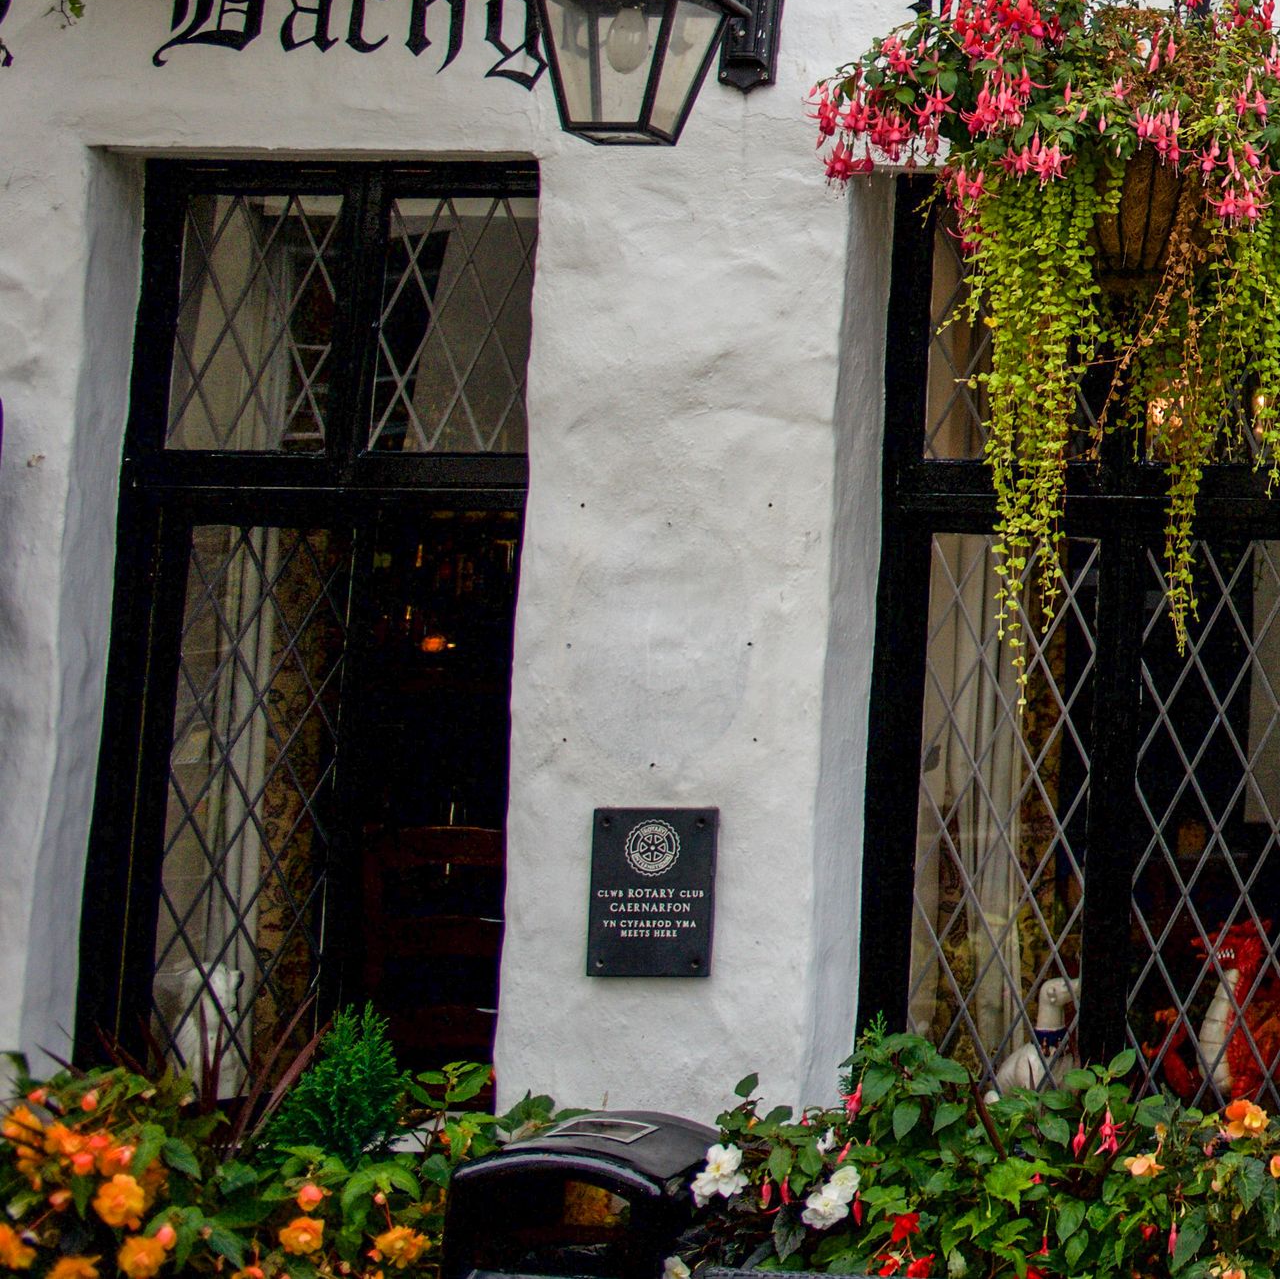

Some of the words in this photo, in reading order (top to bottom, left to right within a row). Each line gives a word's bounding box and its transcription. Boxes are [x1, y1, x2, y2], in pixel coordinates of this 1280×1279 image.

[597, 889, 624, 898] CLWB
[627, 888, 676, 898] ROTARY
[679, 889, 705, 898] CLUB
[609, 902, 691, 913] CAERNARFON
[602, 920, 617, 928] YN
[620, 920, 672, 928] CYFARFOD
[675, 920, 697, 928] YMA
[620, 929, 650, 938] MEETS
[653, 930, 678, 938] HERE
